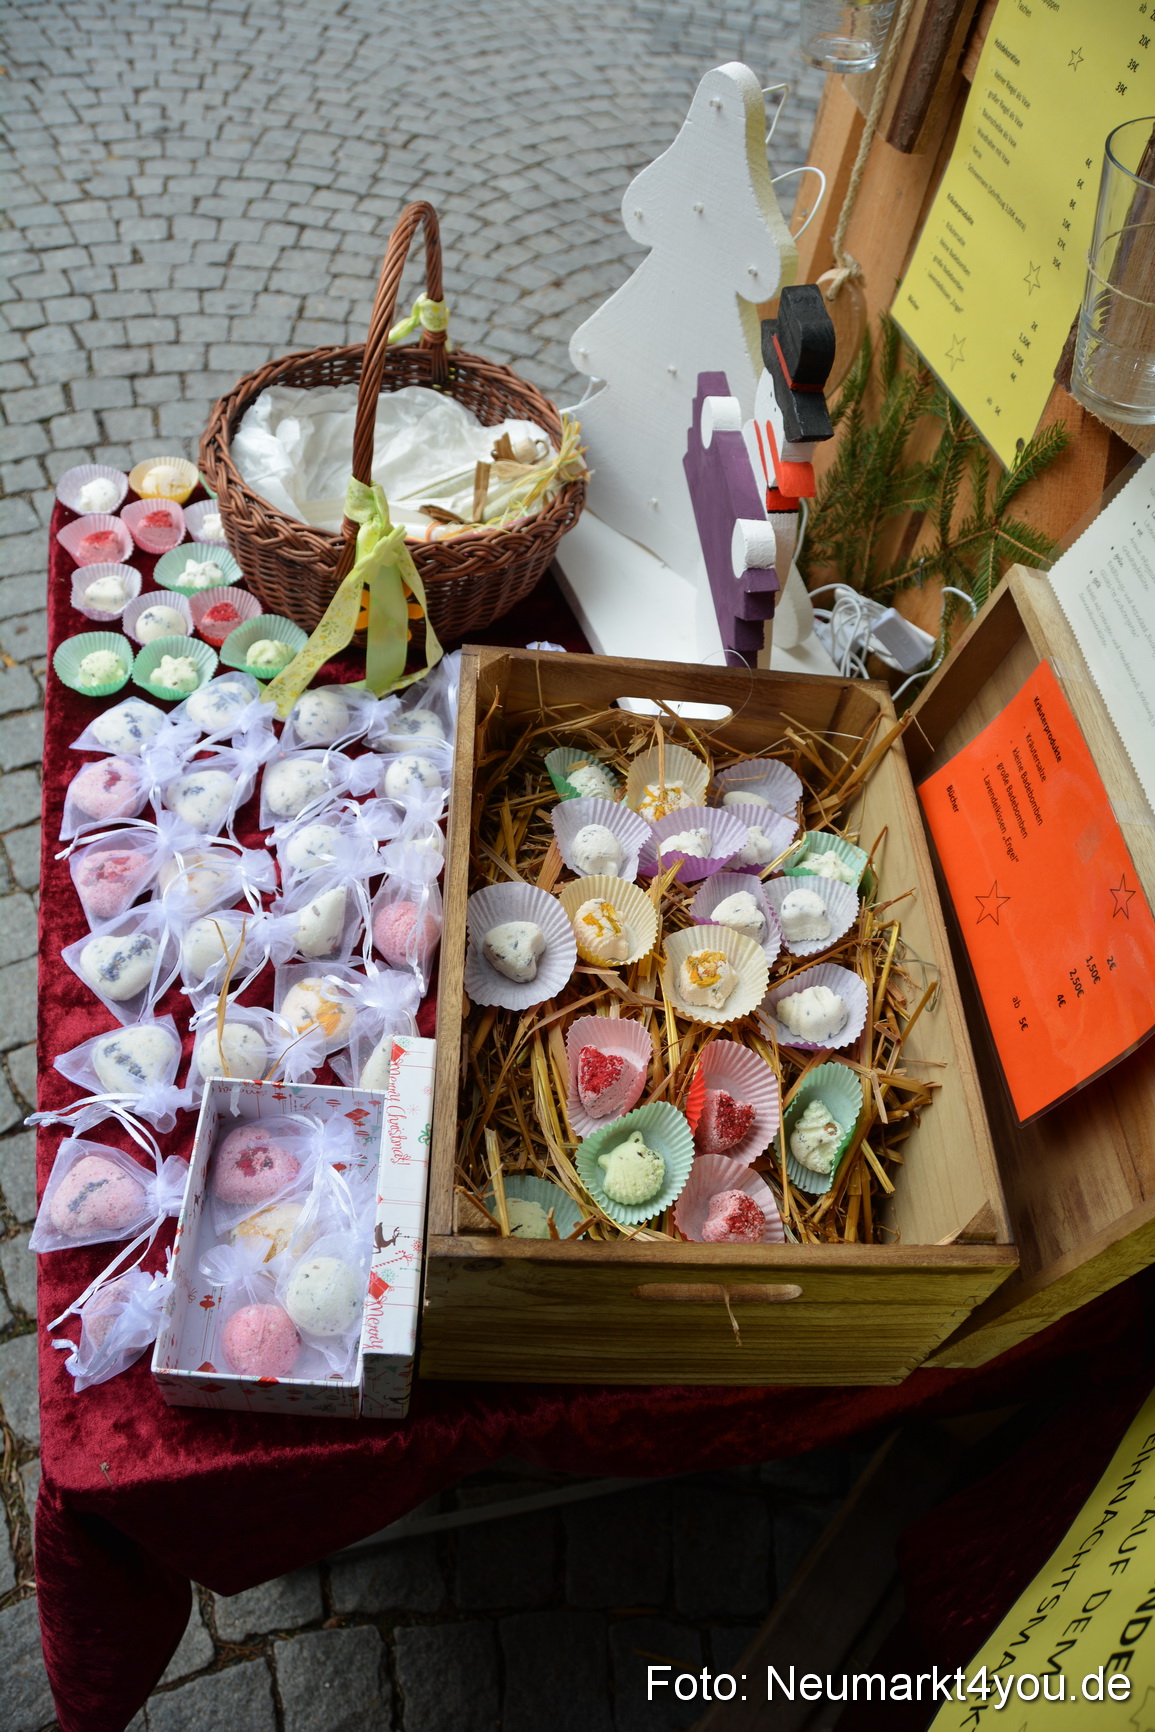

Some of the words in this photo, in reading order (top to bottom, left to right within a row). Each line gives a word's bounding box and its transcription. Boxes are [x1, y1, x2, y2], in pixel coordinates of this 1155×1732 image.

[1127, 58, 1140, 73] 39€
[1138, 34, 1151, 49] 20€
[1115, 81, 1128, 96] 39€
[1031, 321, 1038, 332] 2€
[1033, 695, 1062, 763] Kräuterprodukte
[996, 762, 1010, 786] große
[1006, 784, 1028, 839] Badebomben
[1069, 968, 1085, 998] 2,50€
[1012, 746, 1024, 773] kleine
[1020, 771, 1043, 826] Badebomben
[1085, 955, 1101, 985] 1,50€
[1025, 732, 1047, 783] Kräutersalze
[1106, 955, 1117, 971] 2€
[946, 784, 960, 813] Bücher
[1011, 996, 1022, 1009] ab
[1018, 1017, 1029, 1032] 5€
[983, 774, 1007, 834] Lavendelkissen
[1056, 994, 1067, 1008] 4€
[387, 1058, 404, 1102] Merry
[362, 1295, 388, 1350] Merry
[1039, 1589, 1112, 1678] DEM
